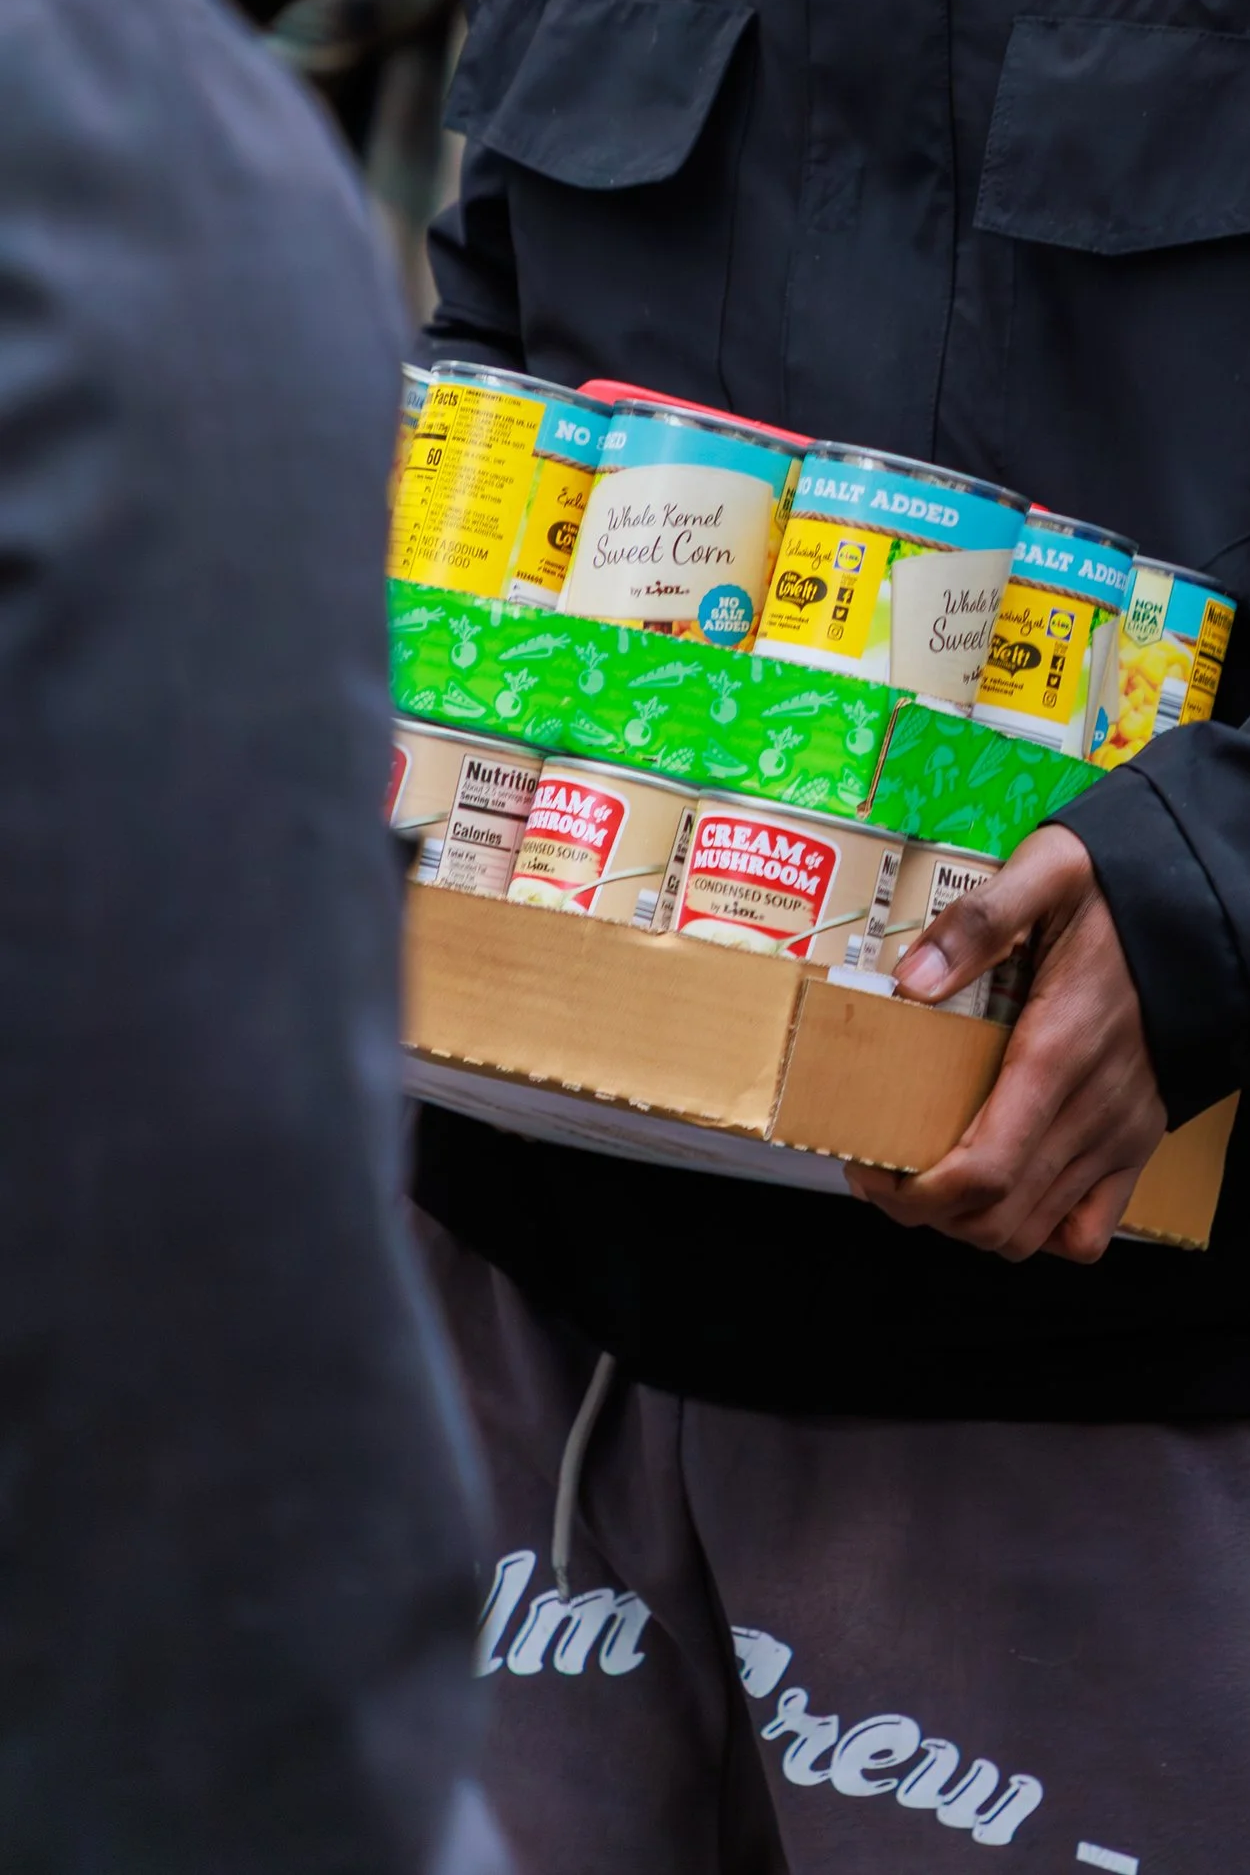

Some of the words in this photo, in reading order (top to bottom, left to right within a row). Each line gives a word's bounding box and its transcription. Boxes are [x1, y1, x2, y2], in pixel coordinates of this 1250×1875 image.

[433, 389, 459, 407] Facts
[554, 419, 591, 446] NO
[426, 447, 443, 466] 60
[813, 478, 865, 504] SALT
[870, 489, 960, 528] ADDED
[607, 504, 657, 531] Whole
[662, 503, 724, 528] Kernel
[418, 548, 439, 562] FREE
[442, 554, 471, 569] FOOD
[421, 536, 440, 548] NOT
[447, 540, 489, 561] SODIUM
[592, 533, 664, 569] Sweet
[672, 529, 736, 566] Corn
[1014, 541, 1074, 572] SALT
[630, 587, 642, 598] by
[718, 596, 740, 609] NO
[943, 589, 985, 616] Whole
[710, 608, 745, 620] SALT
[1134, 597, 1164, 613] NON
[703, 620, 750, 632] ADDED
[1131, 609, 1158, 626] BPA
[929, 615, 987, 653] Sweet
[466, 761, 539, 793] Nutritio
[460, 791, 490, 807] Serving
[491, 796, 506, 808] size
[593, 804, 613, 823] of
[452, 821, 503, 846] Calories
[526, 810, 608, 847] SHROOM
[447, 847, 463, 859] Total
[464, 851, 476, 861] Fat
[557, 846, 589, 862] SOUP
[701, 823, 806, 867] CREAM
[805, 850, 824, 871] of
[693, 849, 821, 896] MUSHROOM
[694, 877, 762, 903] CONDENSED
[763, 894, 802, 911] SOUP
[710, 901, 721, 914] by
